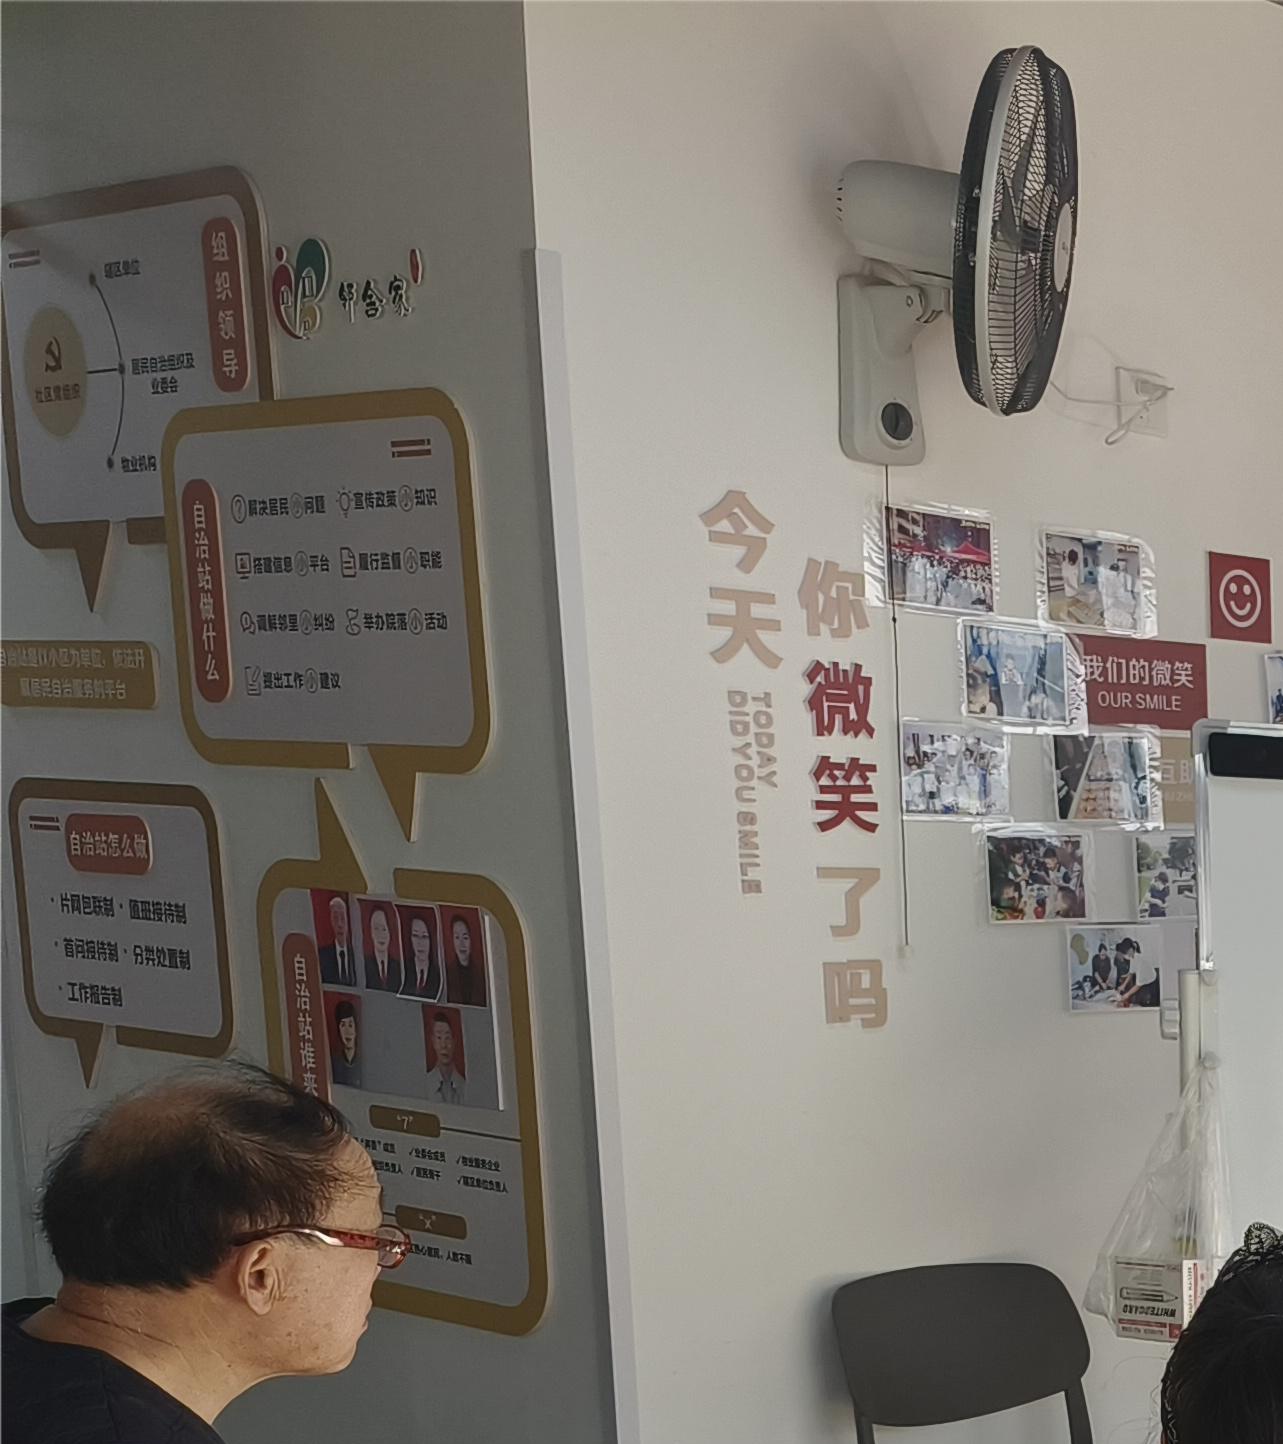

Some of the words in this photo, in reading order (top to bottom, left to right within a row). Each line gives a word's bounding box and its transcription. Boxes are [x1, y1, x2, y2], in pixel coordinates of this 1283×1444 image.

[211, 231, 240, 379] 组织领导
[131, 353, 195, 375] 居民自治组织及
[151, 376, 179, 394] 业委会
[121, 455, 157, 472] 物业机构
[193, 501, 220, 681] 自治站做什么
[698, 488, 785, 670] 今天
[1082, 653, 1195, 690] 我们的微笑
[1097, 690, 1132, 709] OUR
[1136, 693, 1182, 712] SMILE
[751, 691, 778, 788] TODAY
[798, 556, 888, 1031] 你微笑了吗
[69, 831, 149, 860] 自治站怎么做
[128, 898, 188, 925] 值班接待制
[63, 937, 119, 963] 首问接待制
[132, 944, 191, 971] 分类处置制
[66, 981, 123, 1008] 工作报告制
